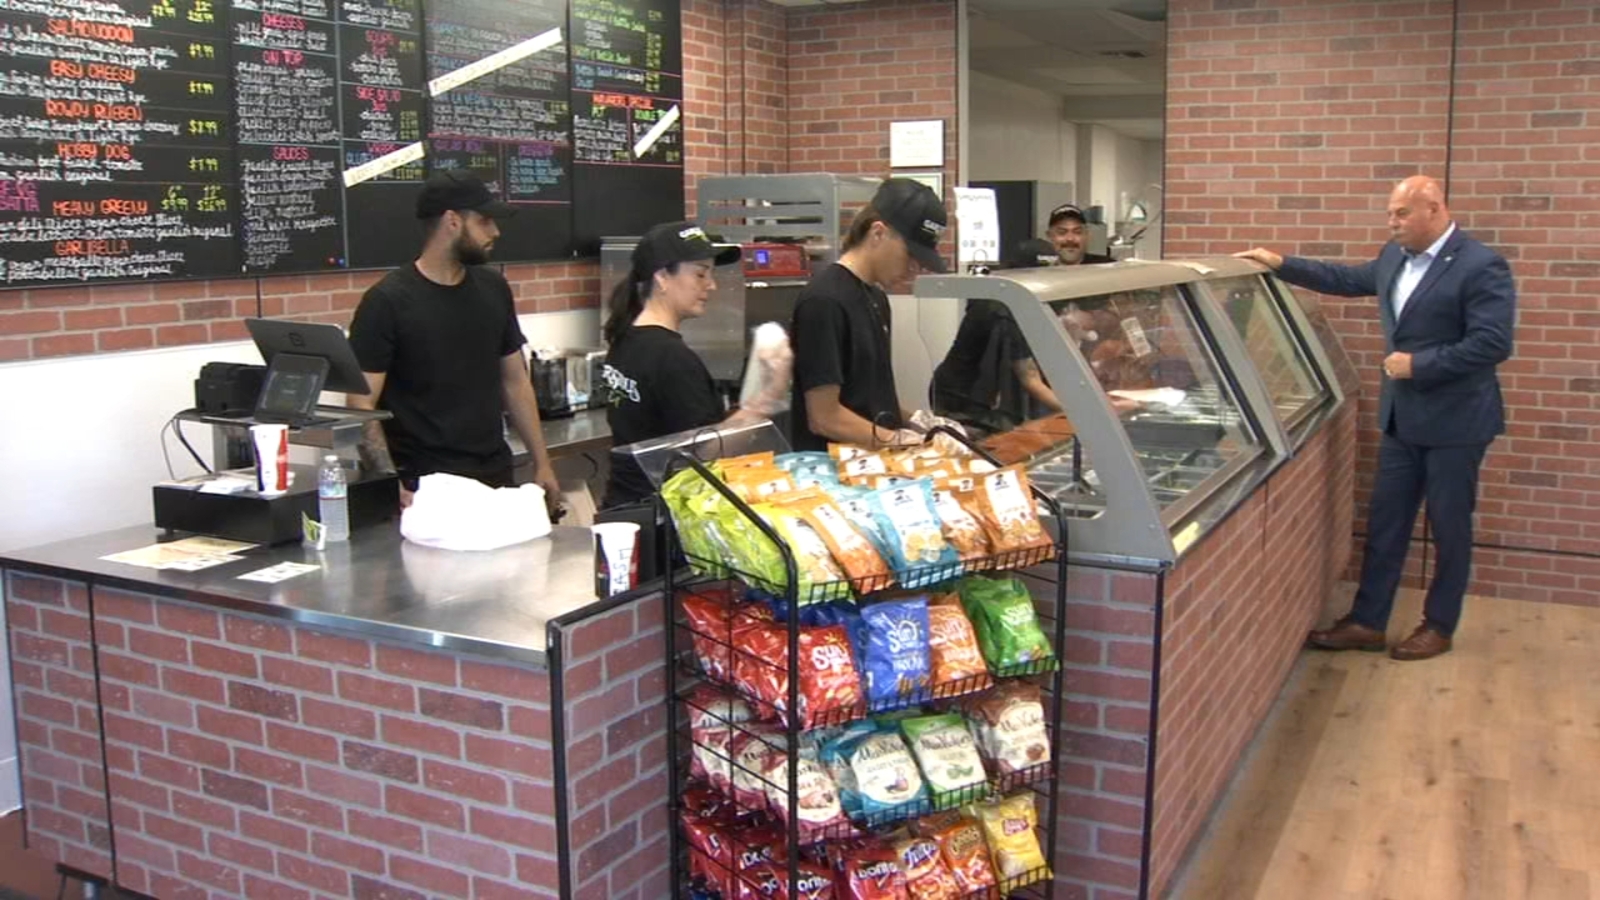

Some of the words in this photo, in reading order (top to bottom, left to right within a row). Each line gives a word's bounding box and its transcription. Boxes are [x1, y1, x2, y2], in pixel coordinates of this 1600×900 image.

[50, 60, 83, 77] EASY
[88, 64, 135, 84] CHEESY
[105, 144, 131, 160] DOG
